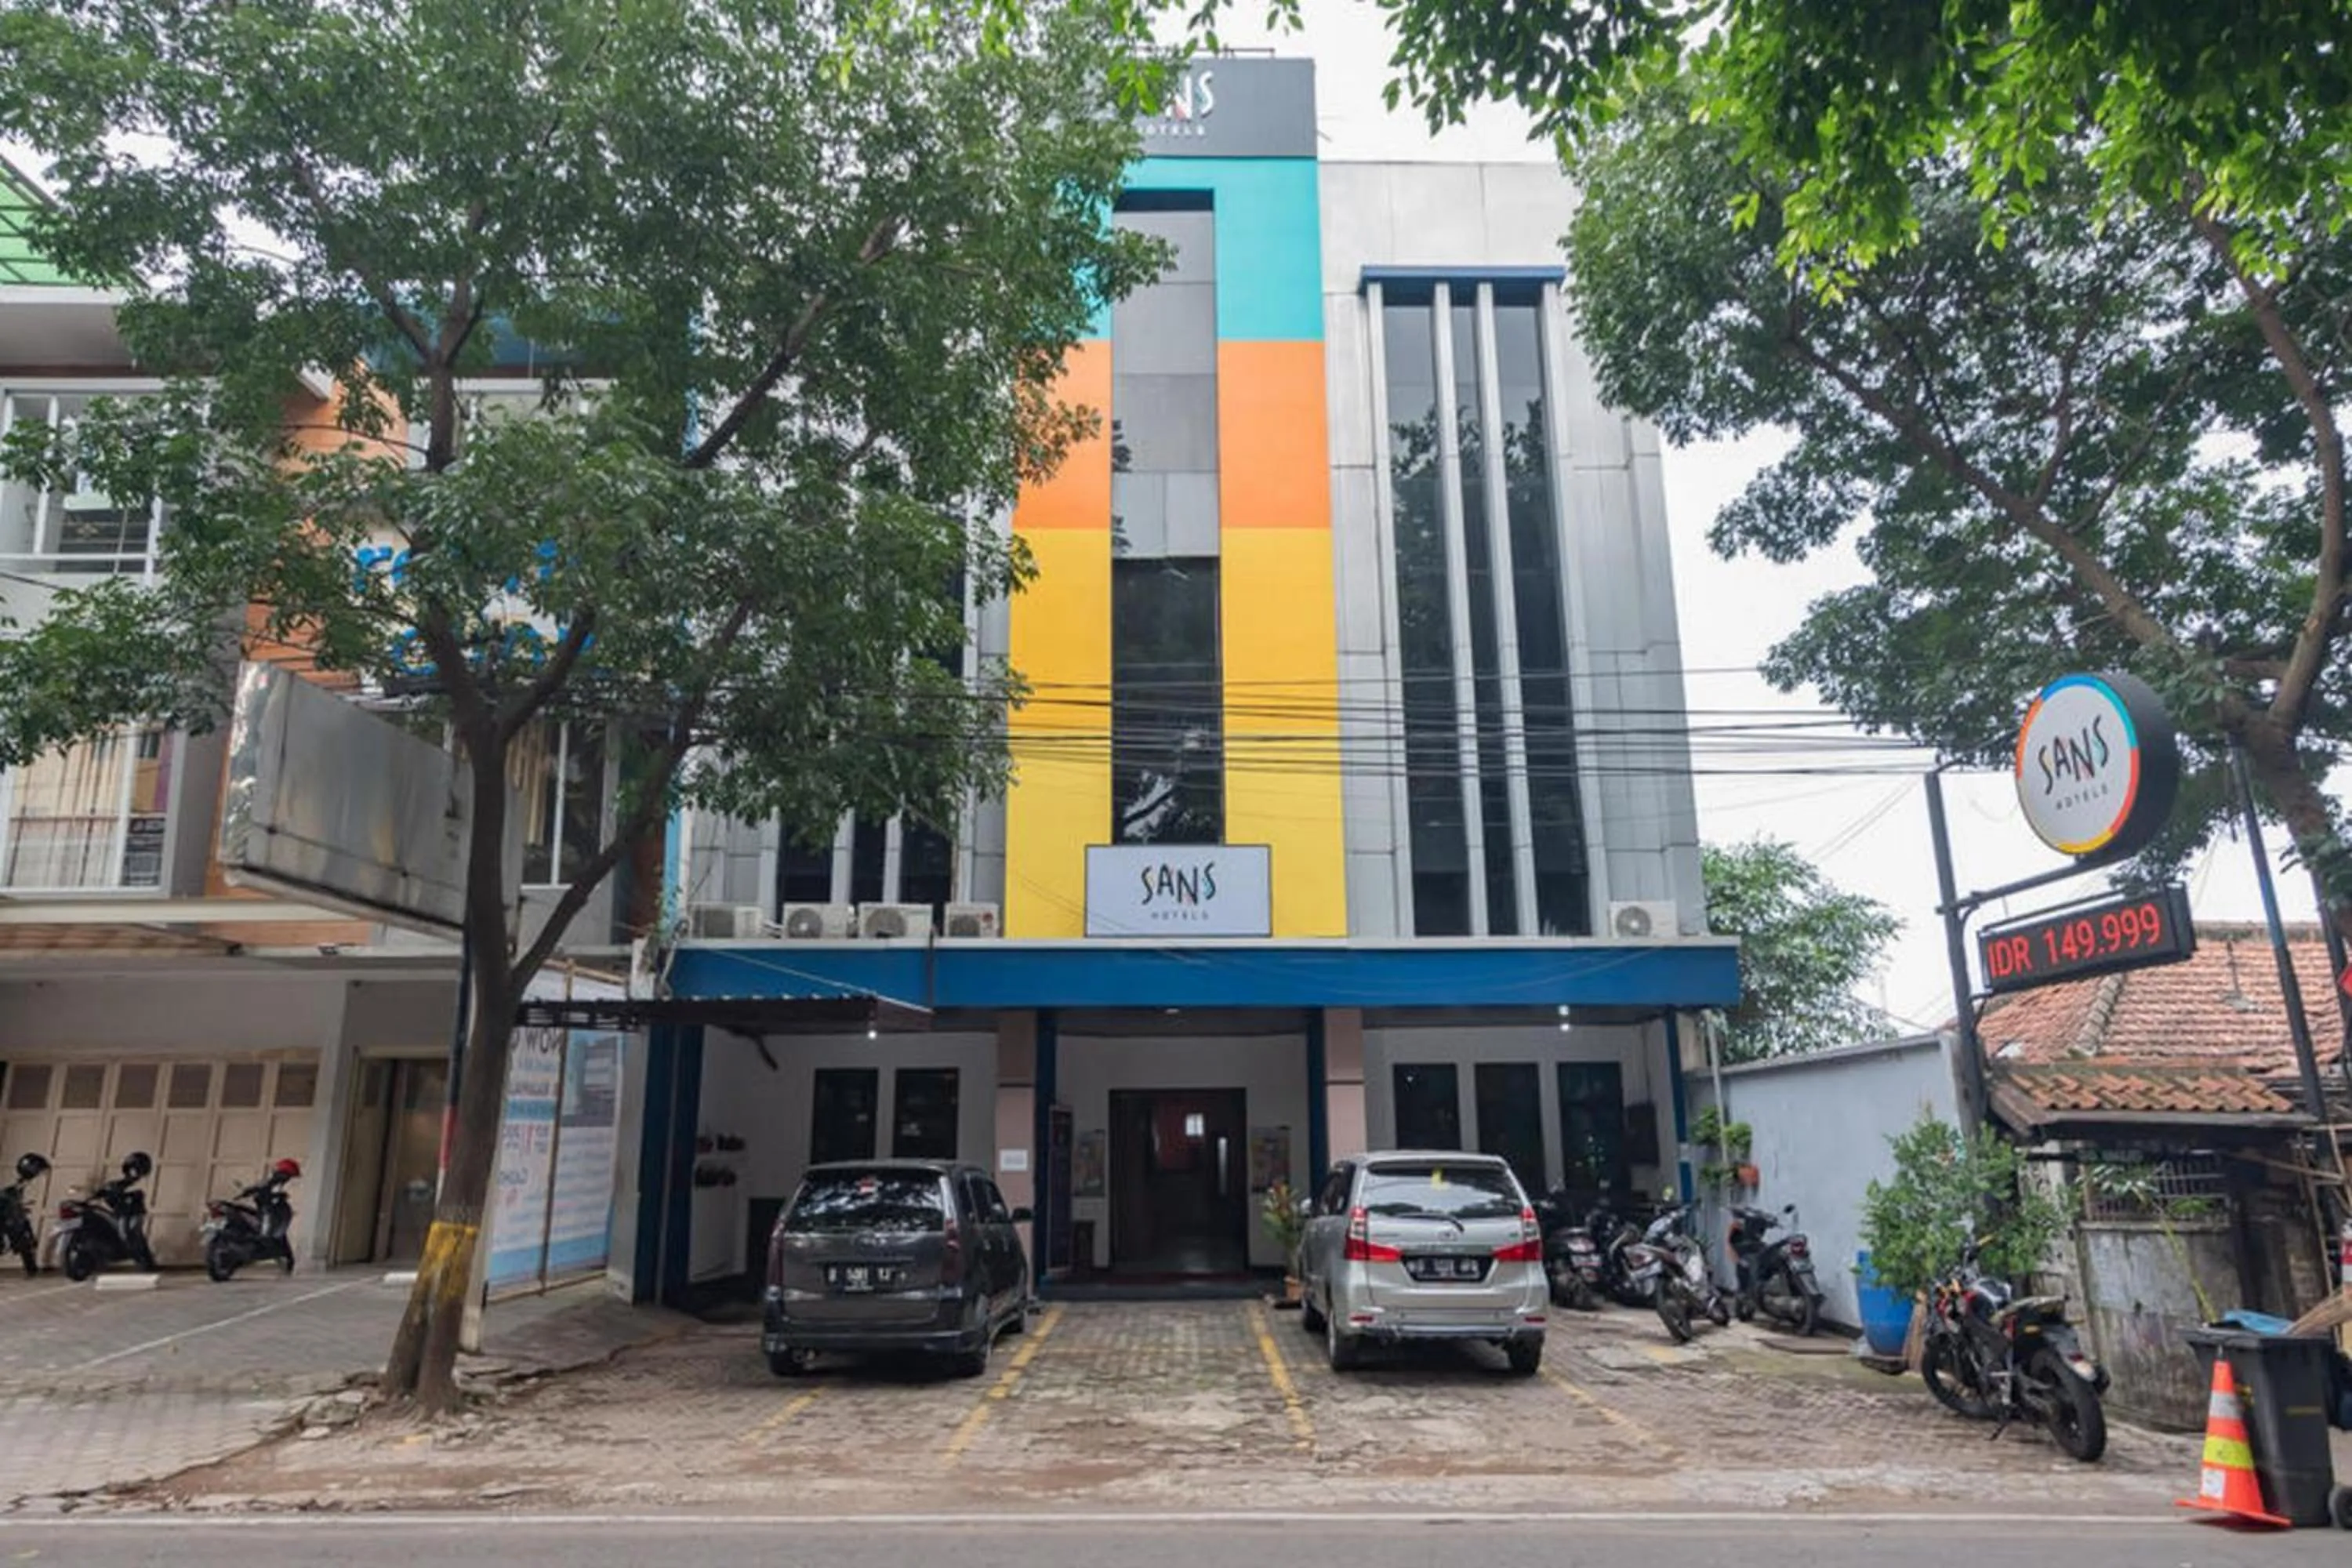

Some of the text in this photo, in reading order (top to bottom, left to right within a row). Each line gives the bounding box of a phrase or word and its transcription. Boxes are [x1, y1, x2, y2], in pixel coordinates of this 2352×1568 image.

[2038, 713, 2109, 796] SANS
[1140, 862, 1217, 906] SANS
[1987, 902, 2161, 979] IDR 149.999
